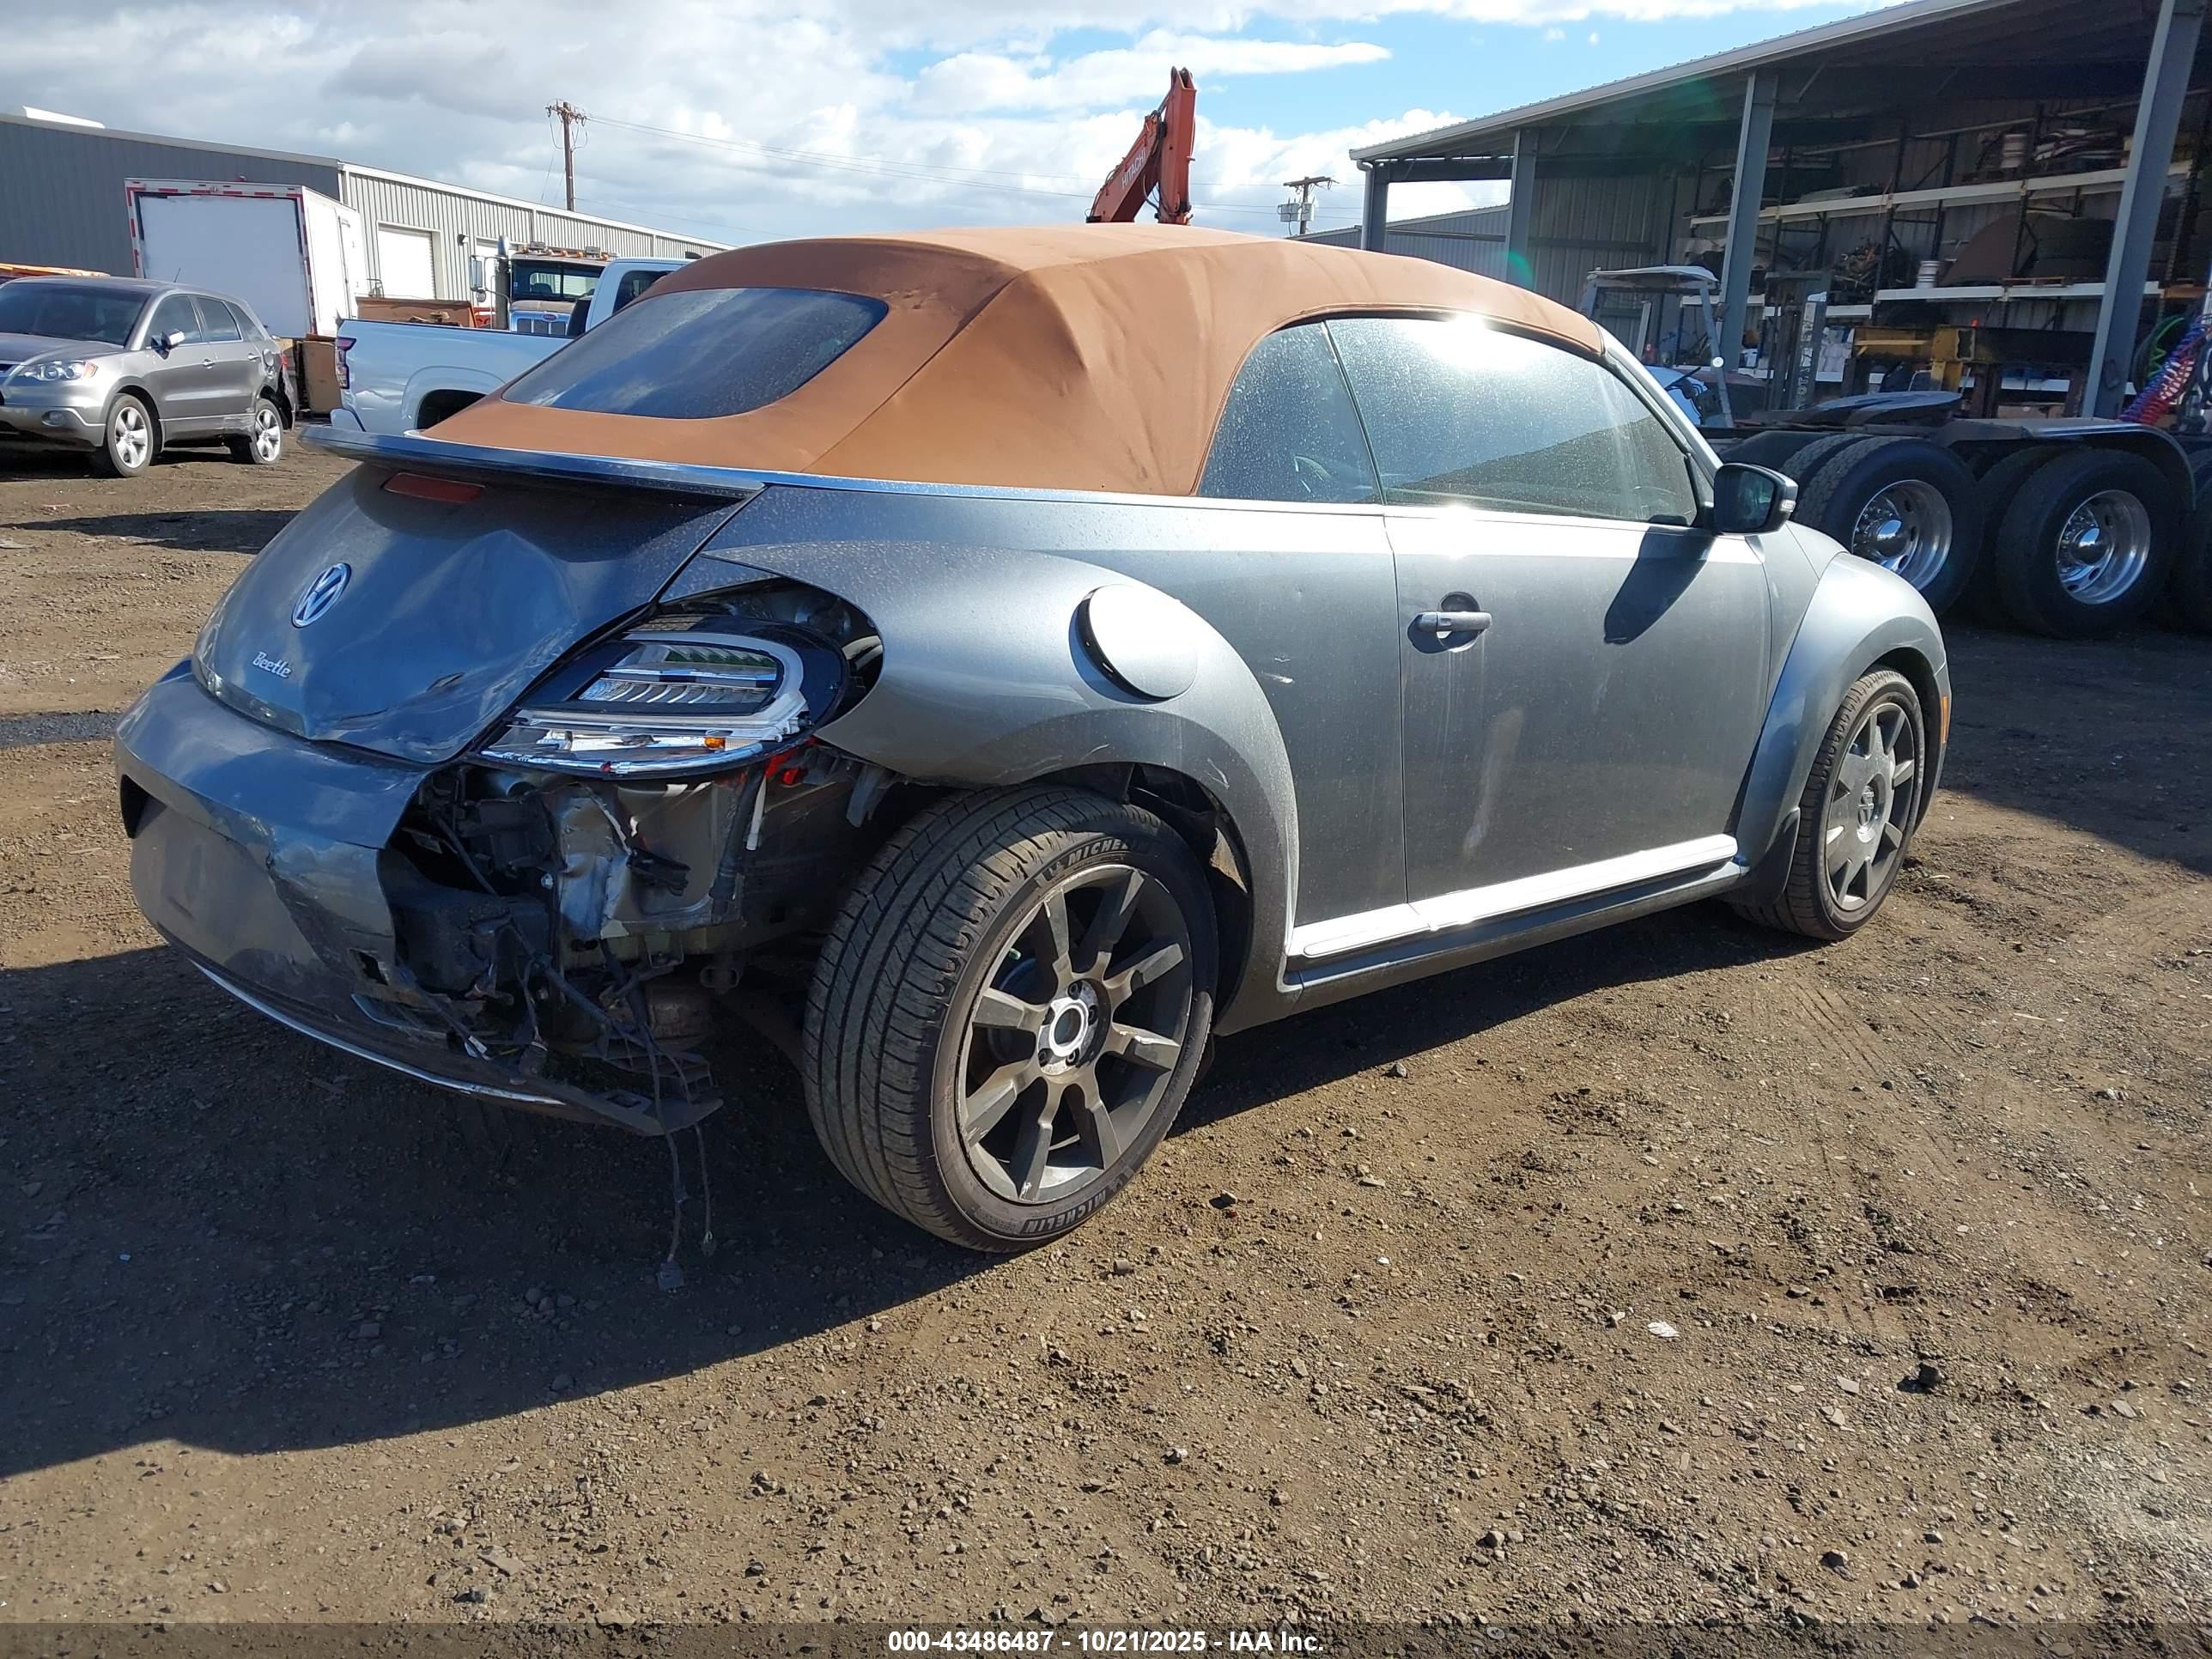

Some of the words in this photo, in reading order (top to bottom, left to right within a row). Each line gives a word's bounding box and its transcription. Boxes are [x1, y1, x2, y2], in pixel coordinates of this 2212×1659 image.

[1121, 148, 1146, 189] HITACHI
[252, 651, 292, 678] Beetle
[1068, 838, 1150, 866] MICHEL
[1024, 1188, 1106, 1233] MICHELIN
